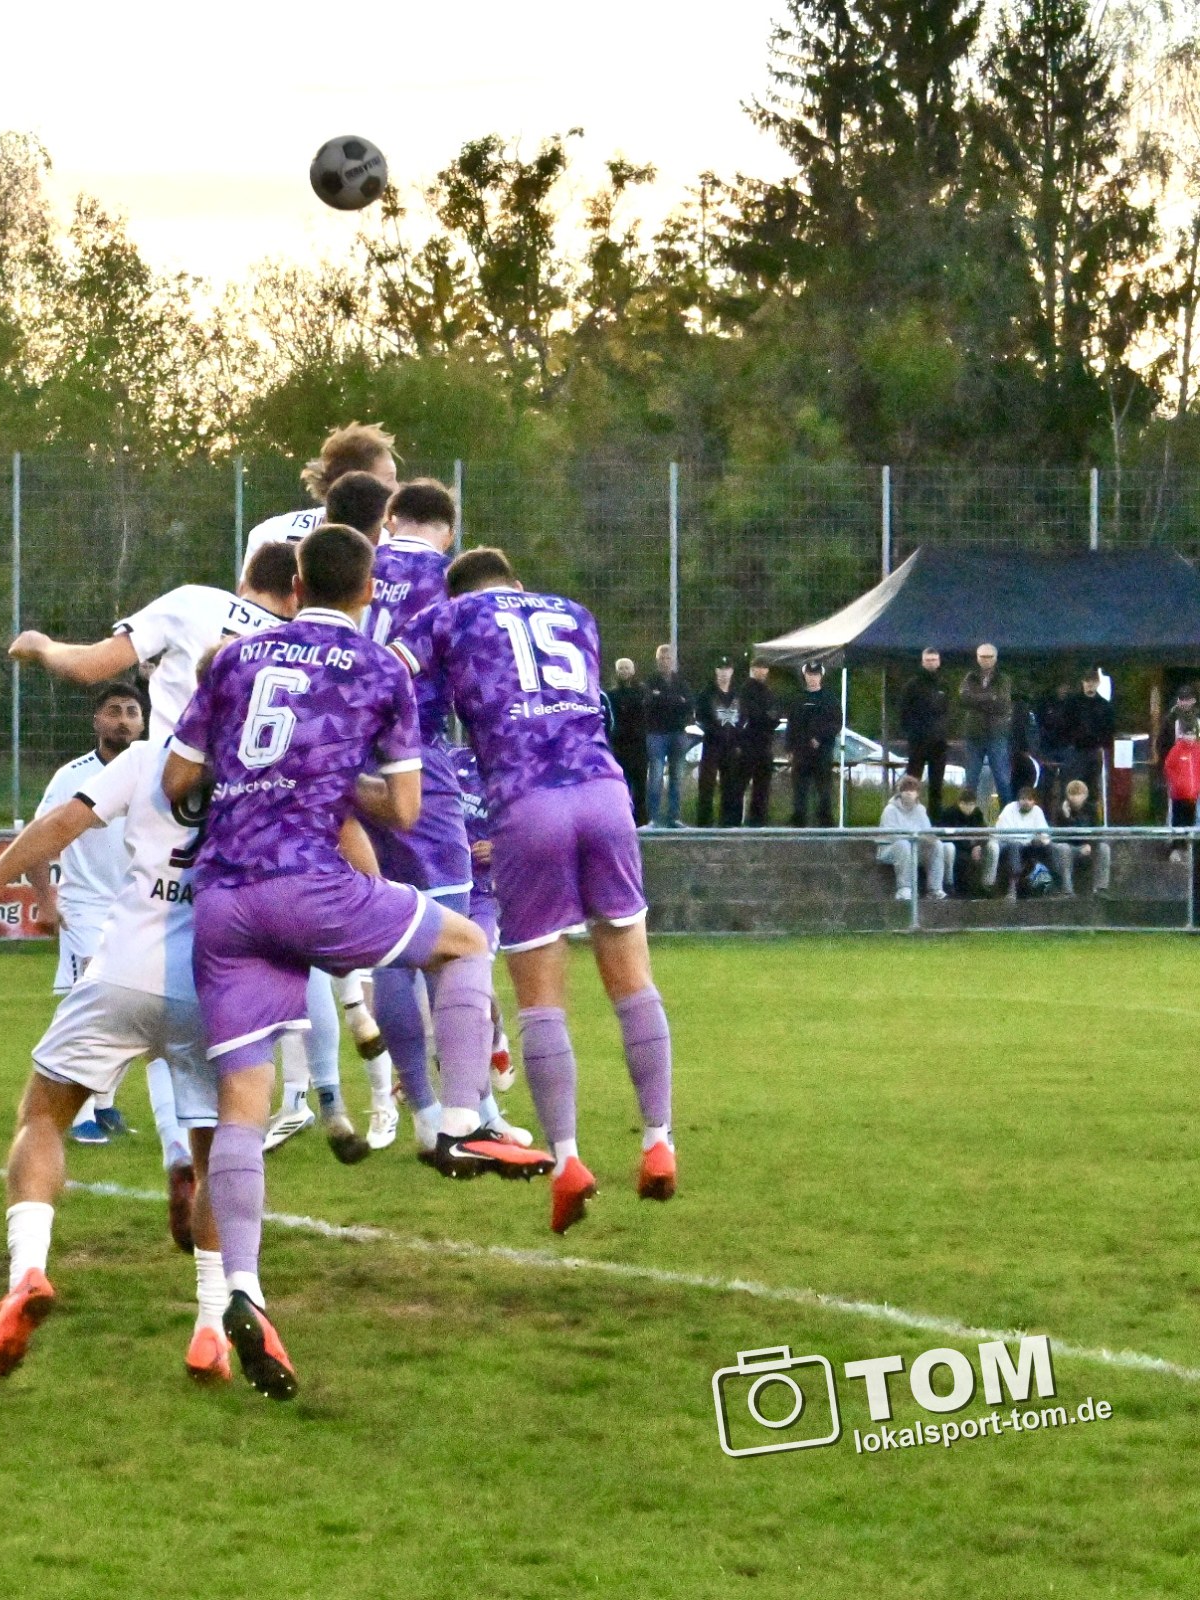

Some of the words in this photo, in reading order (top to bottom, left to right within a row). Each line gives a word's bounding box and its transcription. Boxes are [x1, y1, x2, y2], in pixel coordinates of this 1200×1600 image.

[371, 578, 411, 602] CHER
[494, 596, 566, 612] SCHOLZ
[494, 611, 588, 694] 15
[237, 666, 311, 770] 6
[533, 701, 601, 716] electronics
[149, 878, 194, 906] ABA
